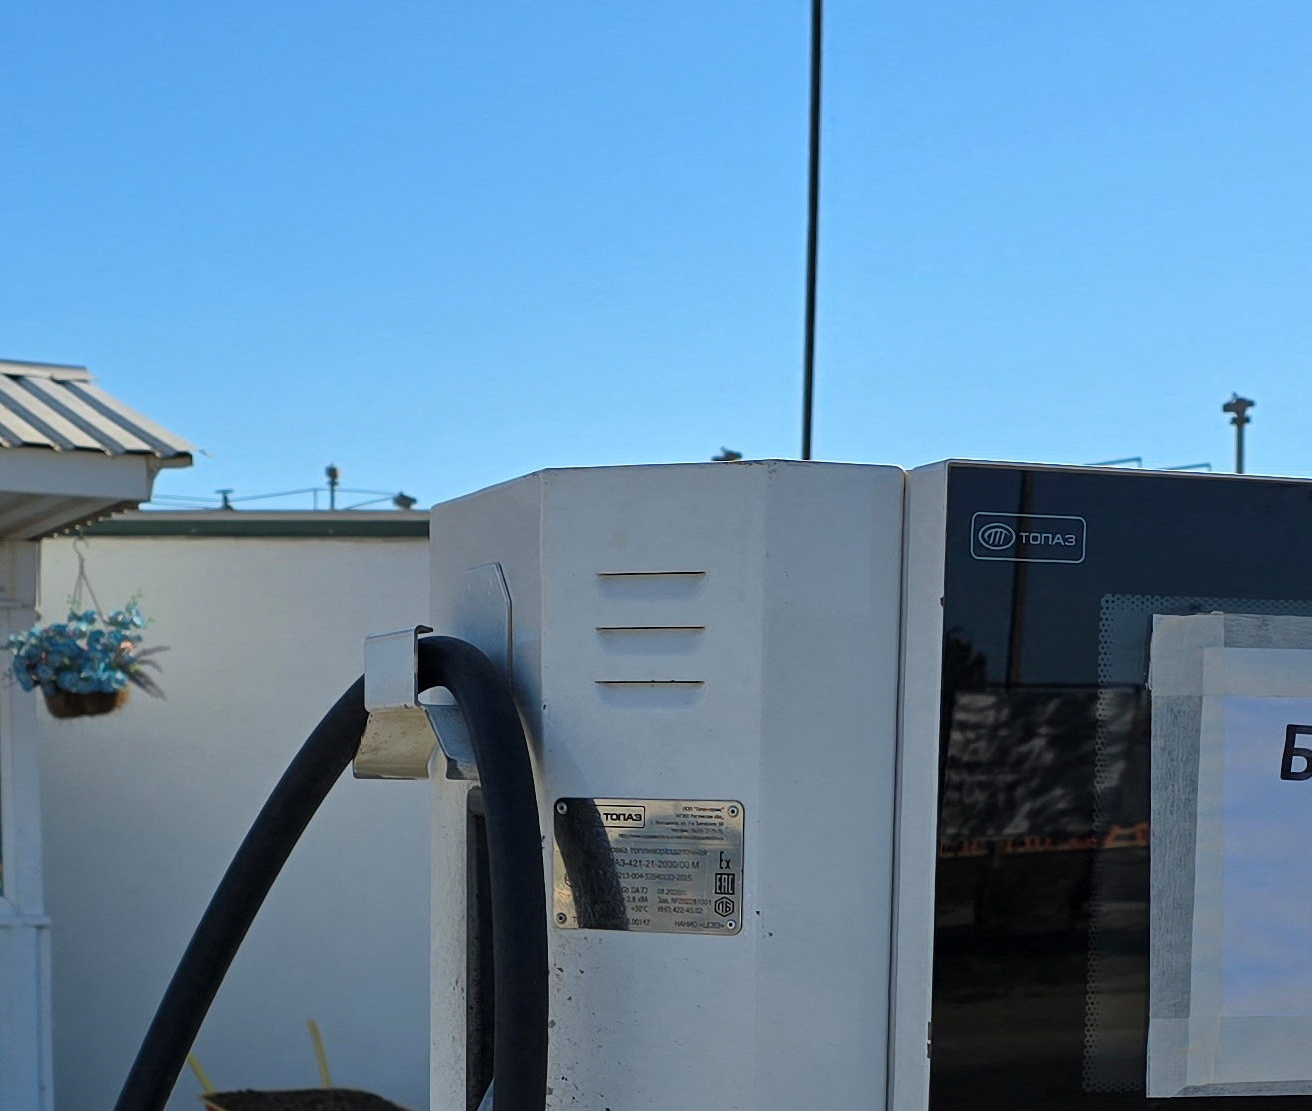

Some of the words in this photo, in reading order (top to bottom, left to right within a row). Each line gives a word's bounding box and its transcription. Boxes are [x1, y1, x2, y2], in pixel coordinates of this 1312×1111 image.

[1020, 532, 1076, 546] ТОПАЗ
[603, 812, 642, 822] ТОПАЗ
[719, 851, 731, 870] Ex
